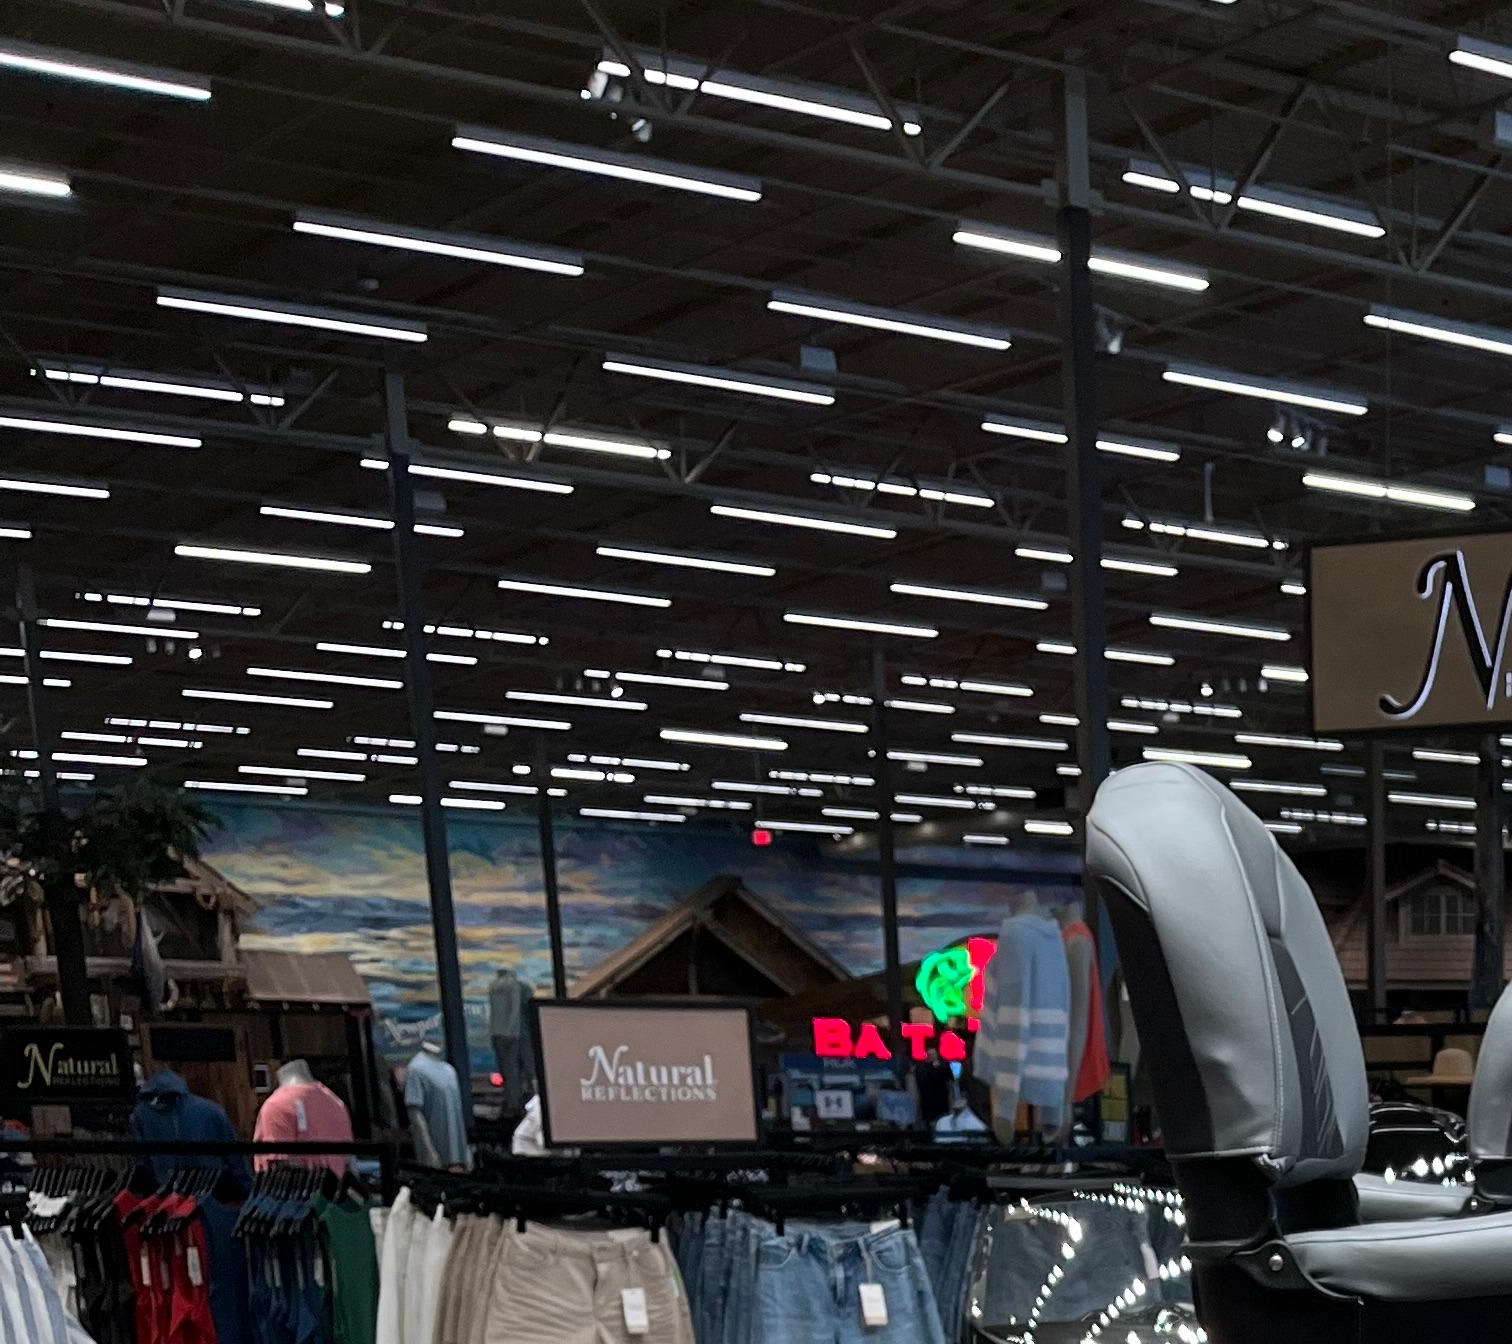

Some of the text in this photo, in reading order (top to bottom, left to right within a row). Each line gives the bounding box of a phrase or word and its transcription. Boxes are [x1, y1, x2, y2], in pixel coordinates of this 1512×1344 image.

[813, 1017, 934, 1061] BAT
[17, 1042, 119, 1088] Natural
[580, 1045, 716, 1086] Natural
[581, 1086, 718, 1101] REFLECTIONS
